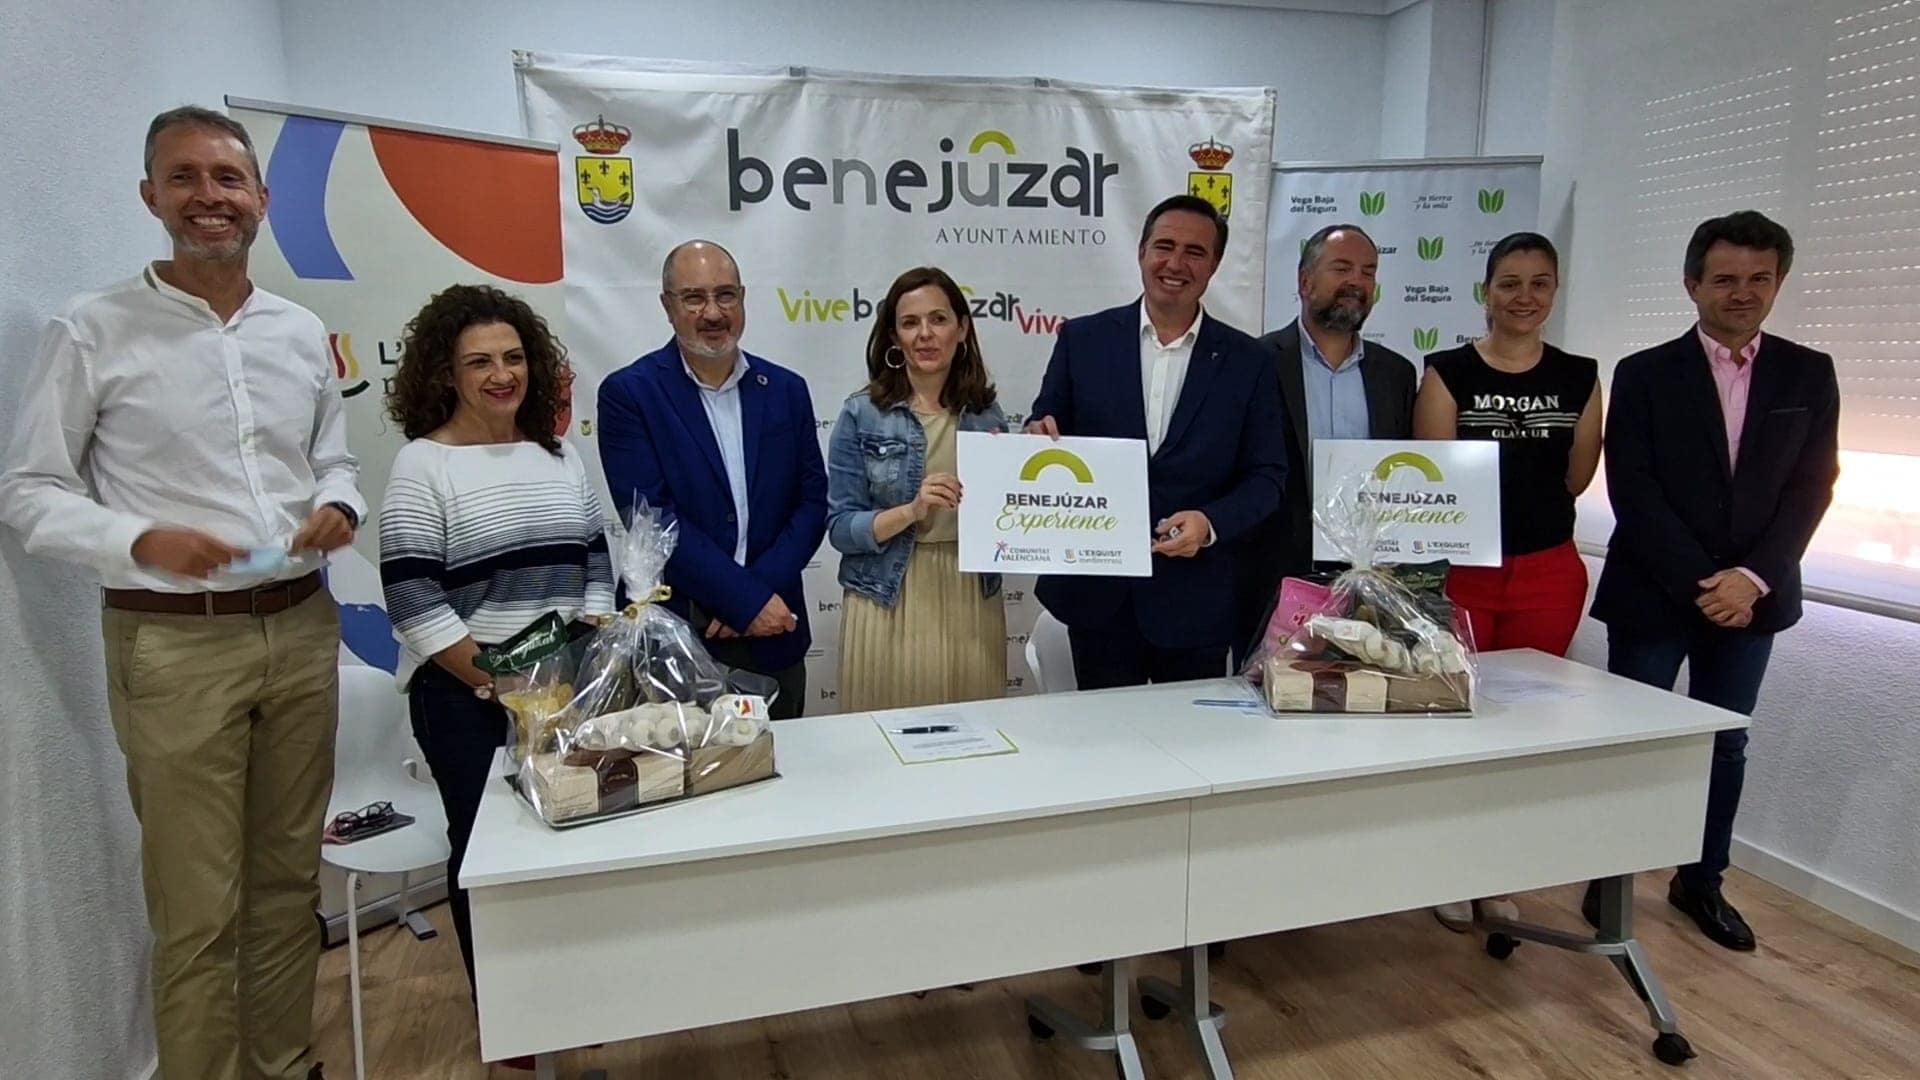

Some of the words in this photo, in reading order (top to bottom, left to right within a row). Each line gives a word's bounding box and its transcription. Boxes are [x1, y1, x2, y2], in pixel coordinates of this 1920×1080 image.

[727, 128, 1119, 217] benejúzar
[1291, 195, 1312, 204] Vega
[1314, 195, 1335, 204] Baja
[1290, 205, 1304, 213] del
[1306, 204, 1337, 215] Segura
[935, 226, 1107, 246] AYUNTAMIENTO
[1404, 284, 1427, 294] Vega
[1429, 284, 1450, 294] Baja
[1404, 294, 1418, 302] del
[1420, 294, 1453, 304] Segura
[1473, 394, 1560, 412] MORGAN
[1006, 492, 1108, 509] BENEJÚZAR
[1357, 490, 1458, 506] BNEJÚZAR
[996, 504, 1118, 535] Experience
